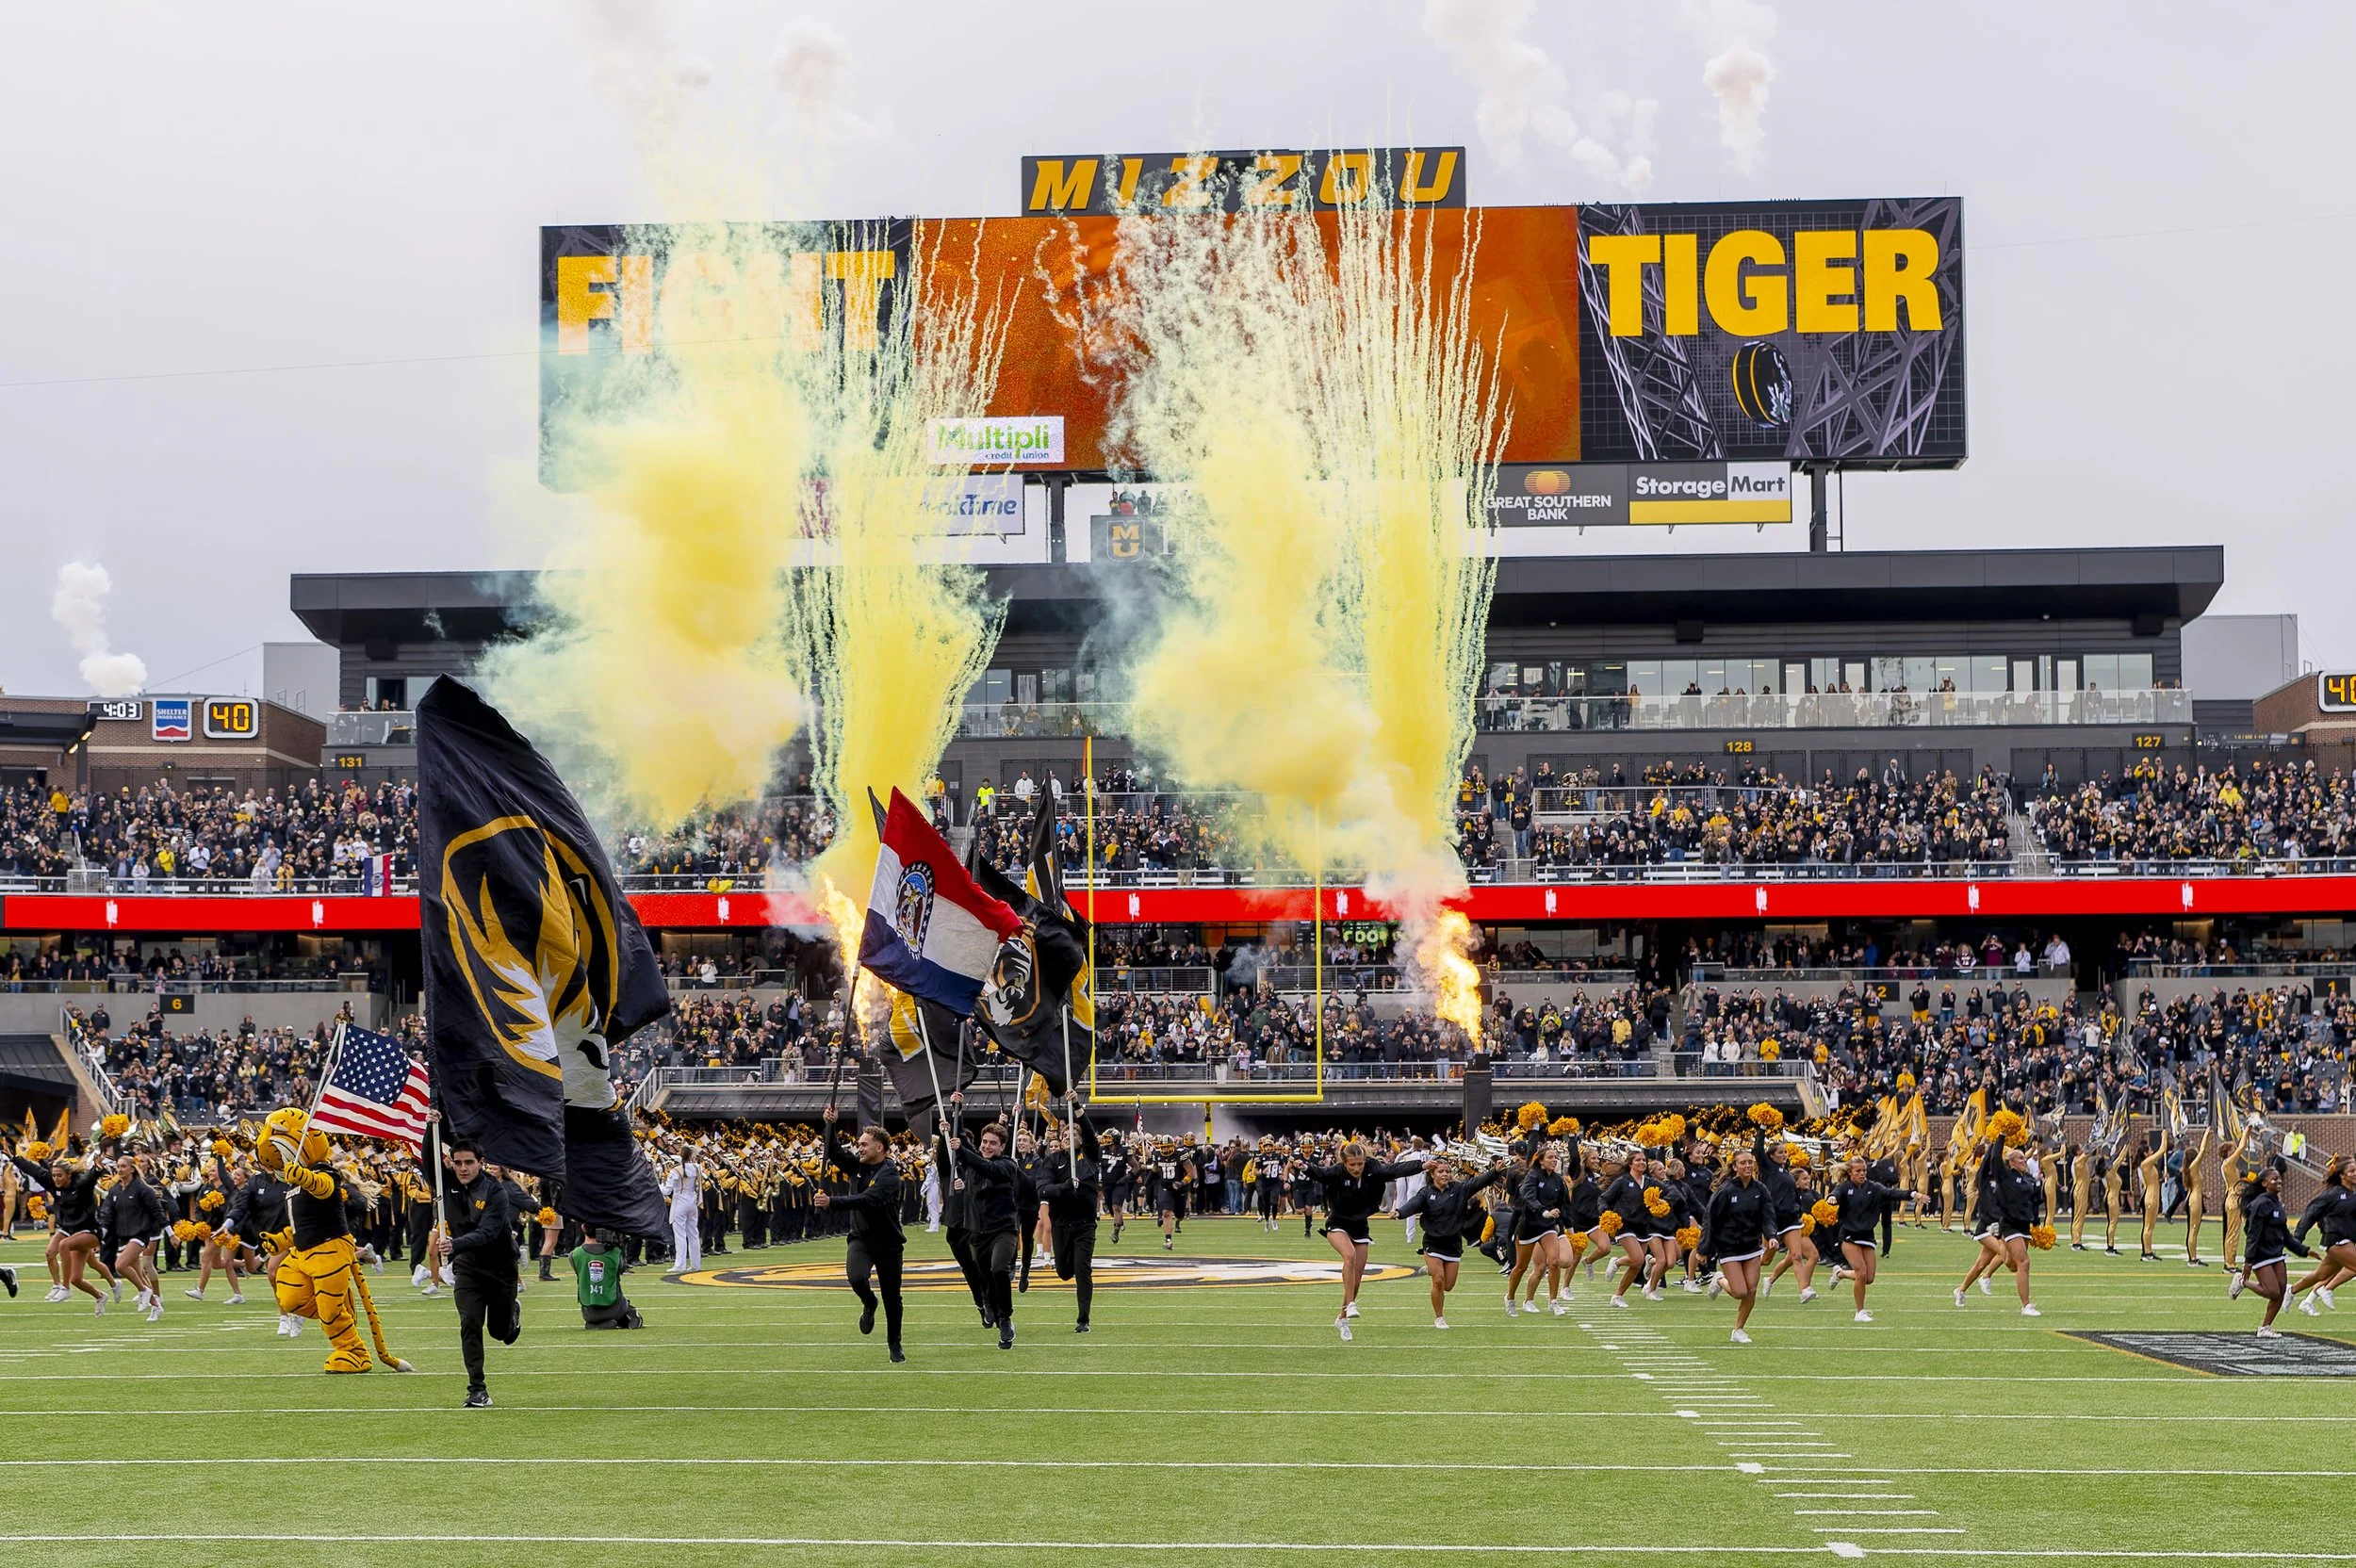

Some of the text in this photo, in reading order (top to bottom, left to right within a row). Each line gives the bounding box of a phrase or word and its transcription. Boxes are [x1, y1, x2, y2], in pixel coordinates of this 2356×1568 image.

[1029, 151, 1458, 212] MIZZOU
[1588, 229, 1943, 337] TIGER
[939, 424, 1050, 459] Multipli
[1023, 451, 1050, 460] union
[1486, 495, 1612, 508] GREAT SOUTHERN
[1527, 508, 1568, 520] BANK
[103, 703, 138, 718] 4:03
[212, 704, 250, 732] 40
[1726, 741, 1753, 753] 128
[2135, 736, 2162, 747] 127
[338, 757, 363, 768] 131
[1877, 986, 1887, 998] 2
[172, 998, 183, 1010] 6
[1106, 1159, 1118, 1173] 7
[1161, 1166, 1176, 1180] 10
[475, 1199, 486, 1209] M
